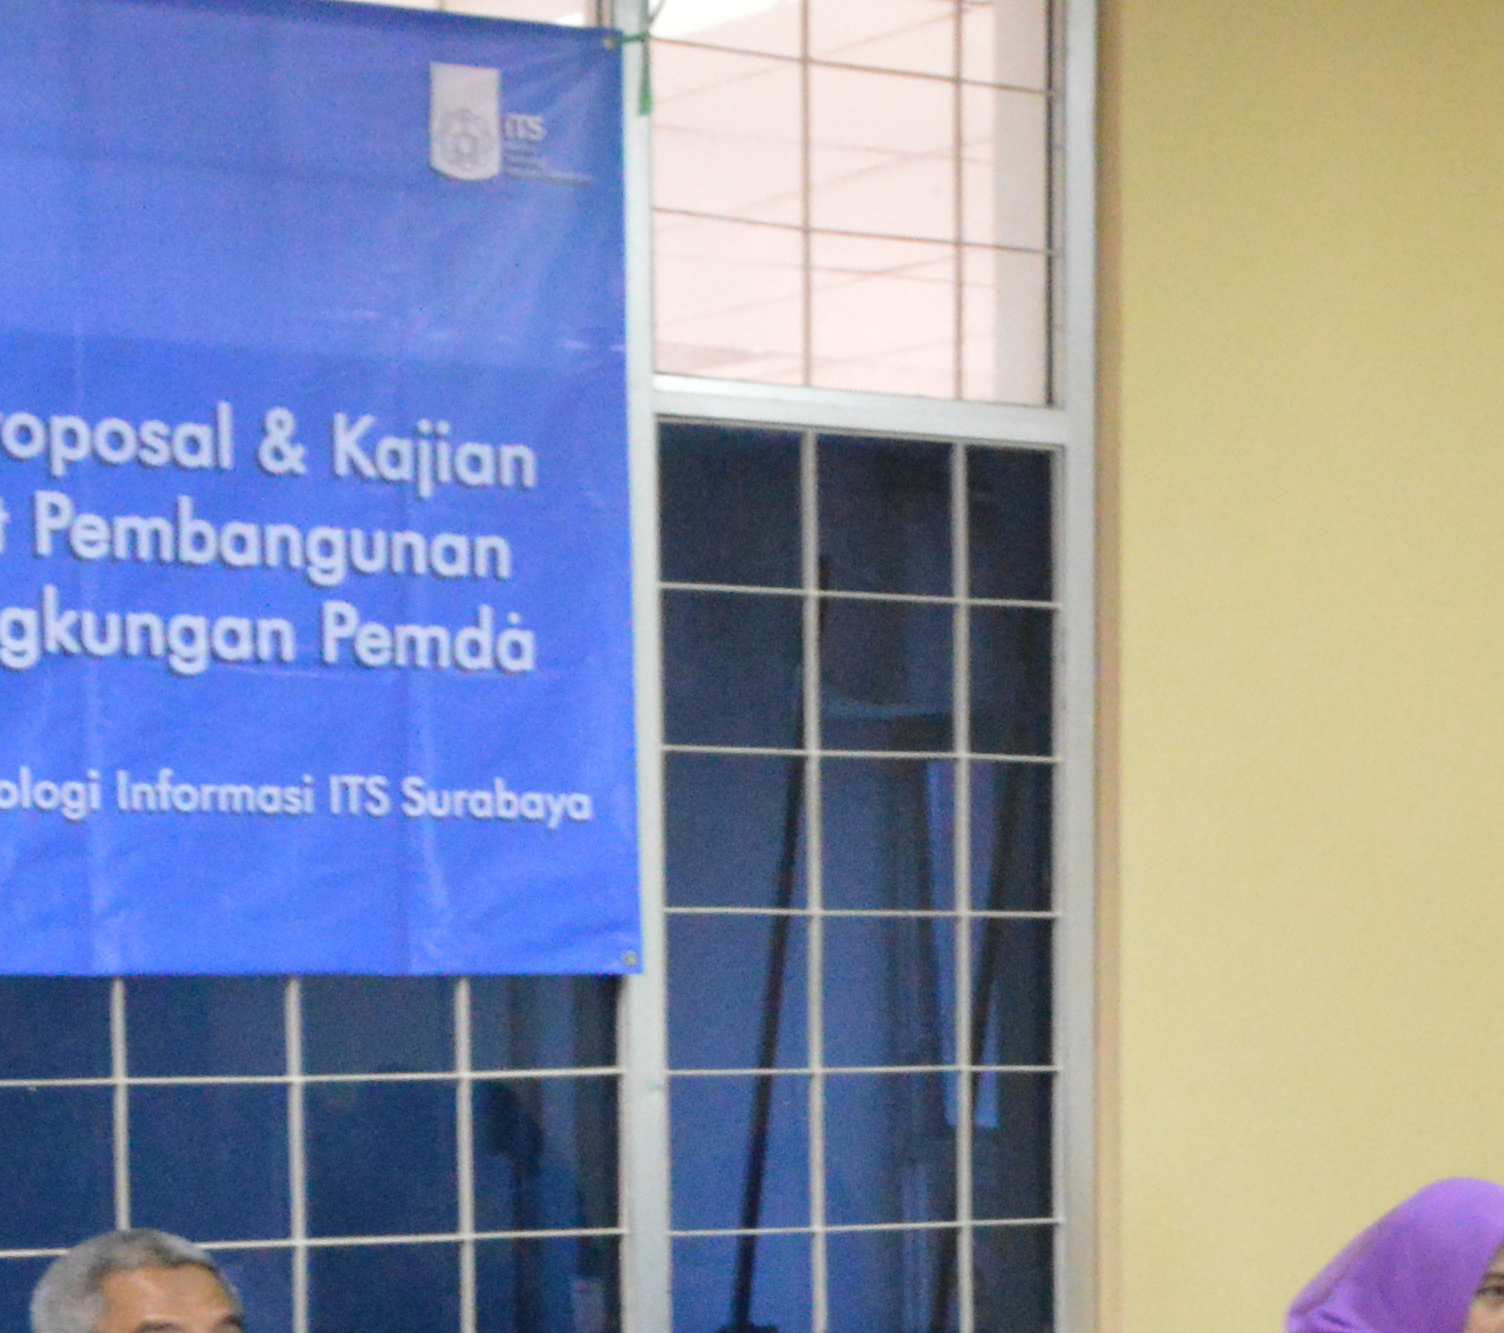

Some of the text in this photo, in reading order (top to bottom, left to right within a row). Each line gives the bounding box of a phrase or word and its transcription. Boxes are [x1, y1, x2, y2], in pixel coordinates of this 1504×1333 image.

[258, 407, 308, 475] &
[333, 412, 537, 497] Kajian
[35, 490, 513, 585] Pembangunan
[116, 767, 315, 816] Informasi
[329, 774, 392, 816] ITS
[401, 774, 594, 829] Surabaya
